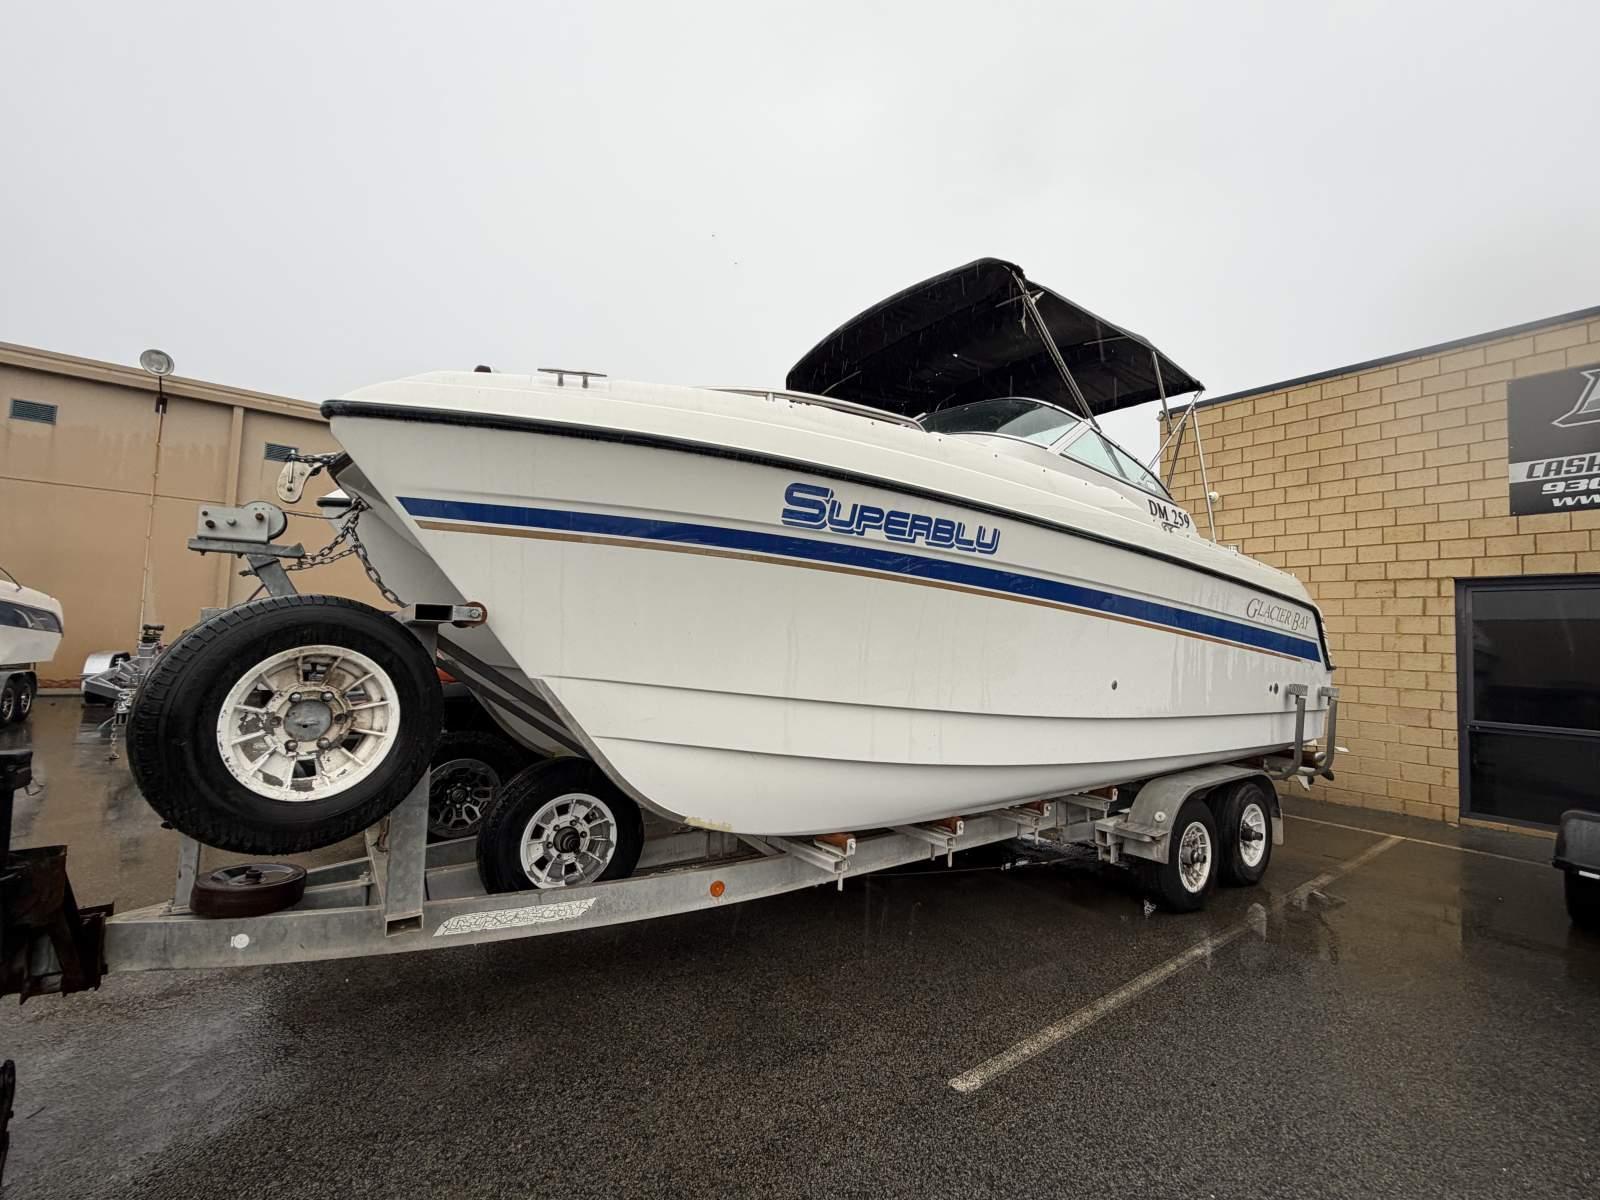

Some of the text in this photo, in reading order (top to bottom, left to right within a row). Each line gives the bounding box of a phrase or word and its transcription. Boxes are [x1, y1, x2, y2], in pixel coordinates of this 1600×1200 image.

[782, 482, 1000, 555] SUPERBLU
[1148, 499, 1190, 528] DM 259
[1246, 598, 1309, 630] GLACIER BAY
